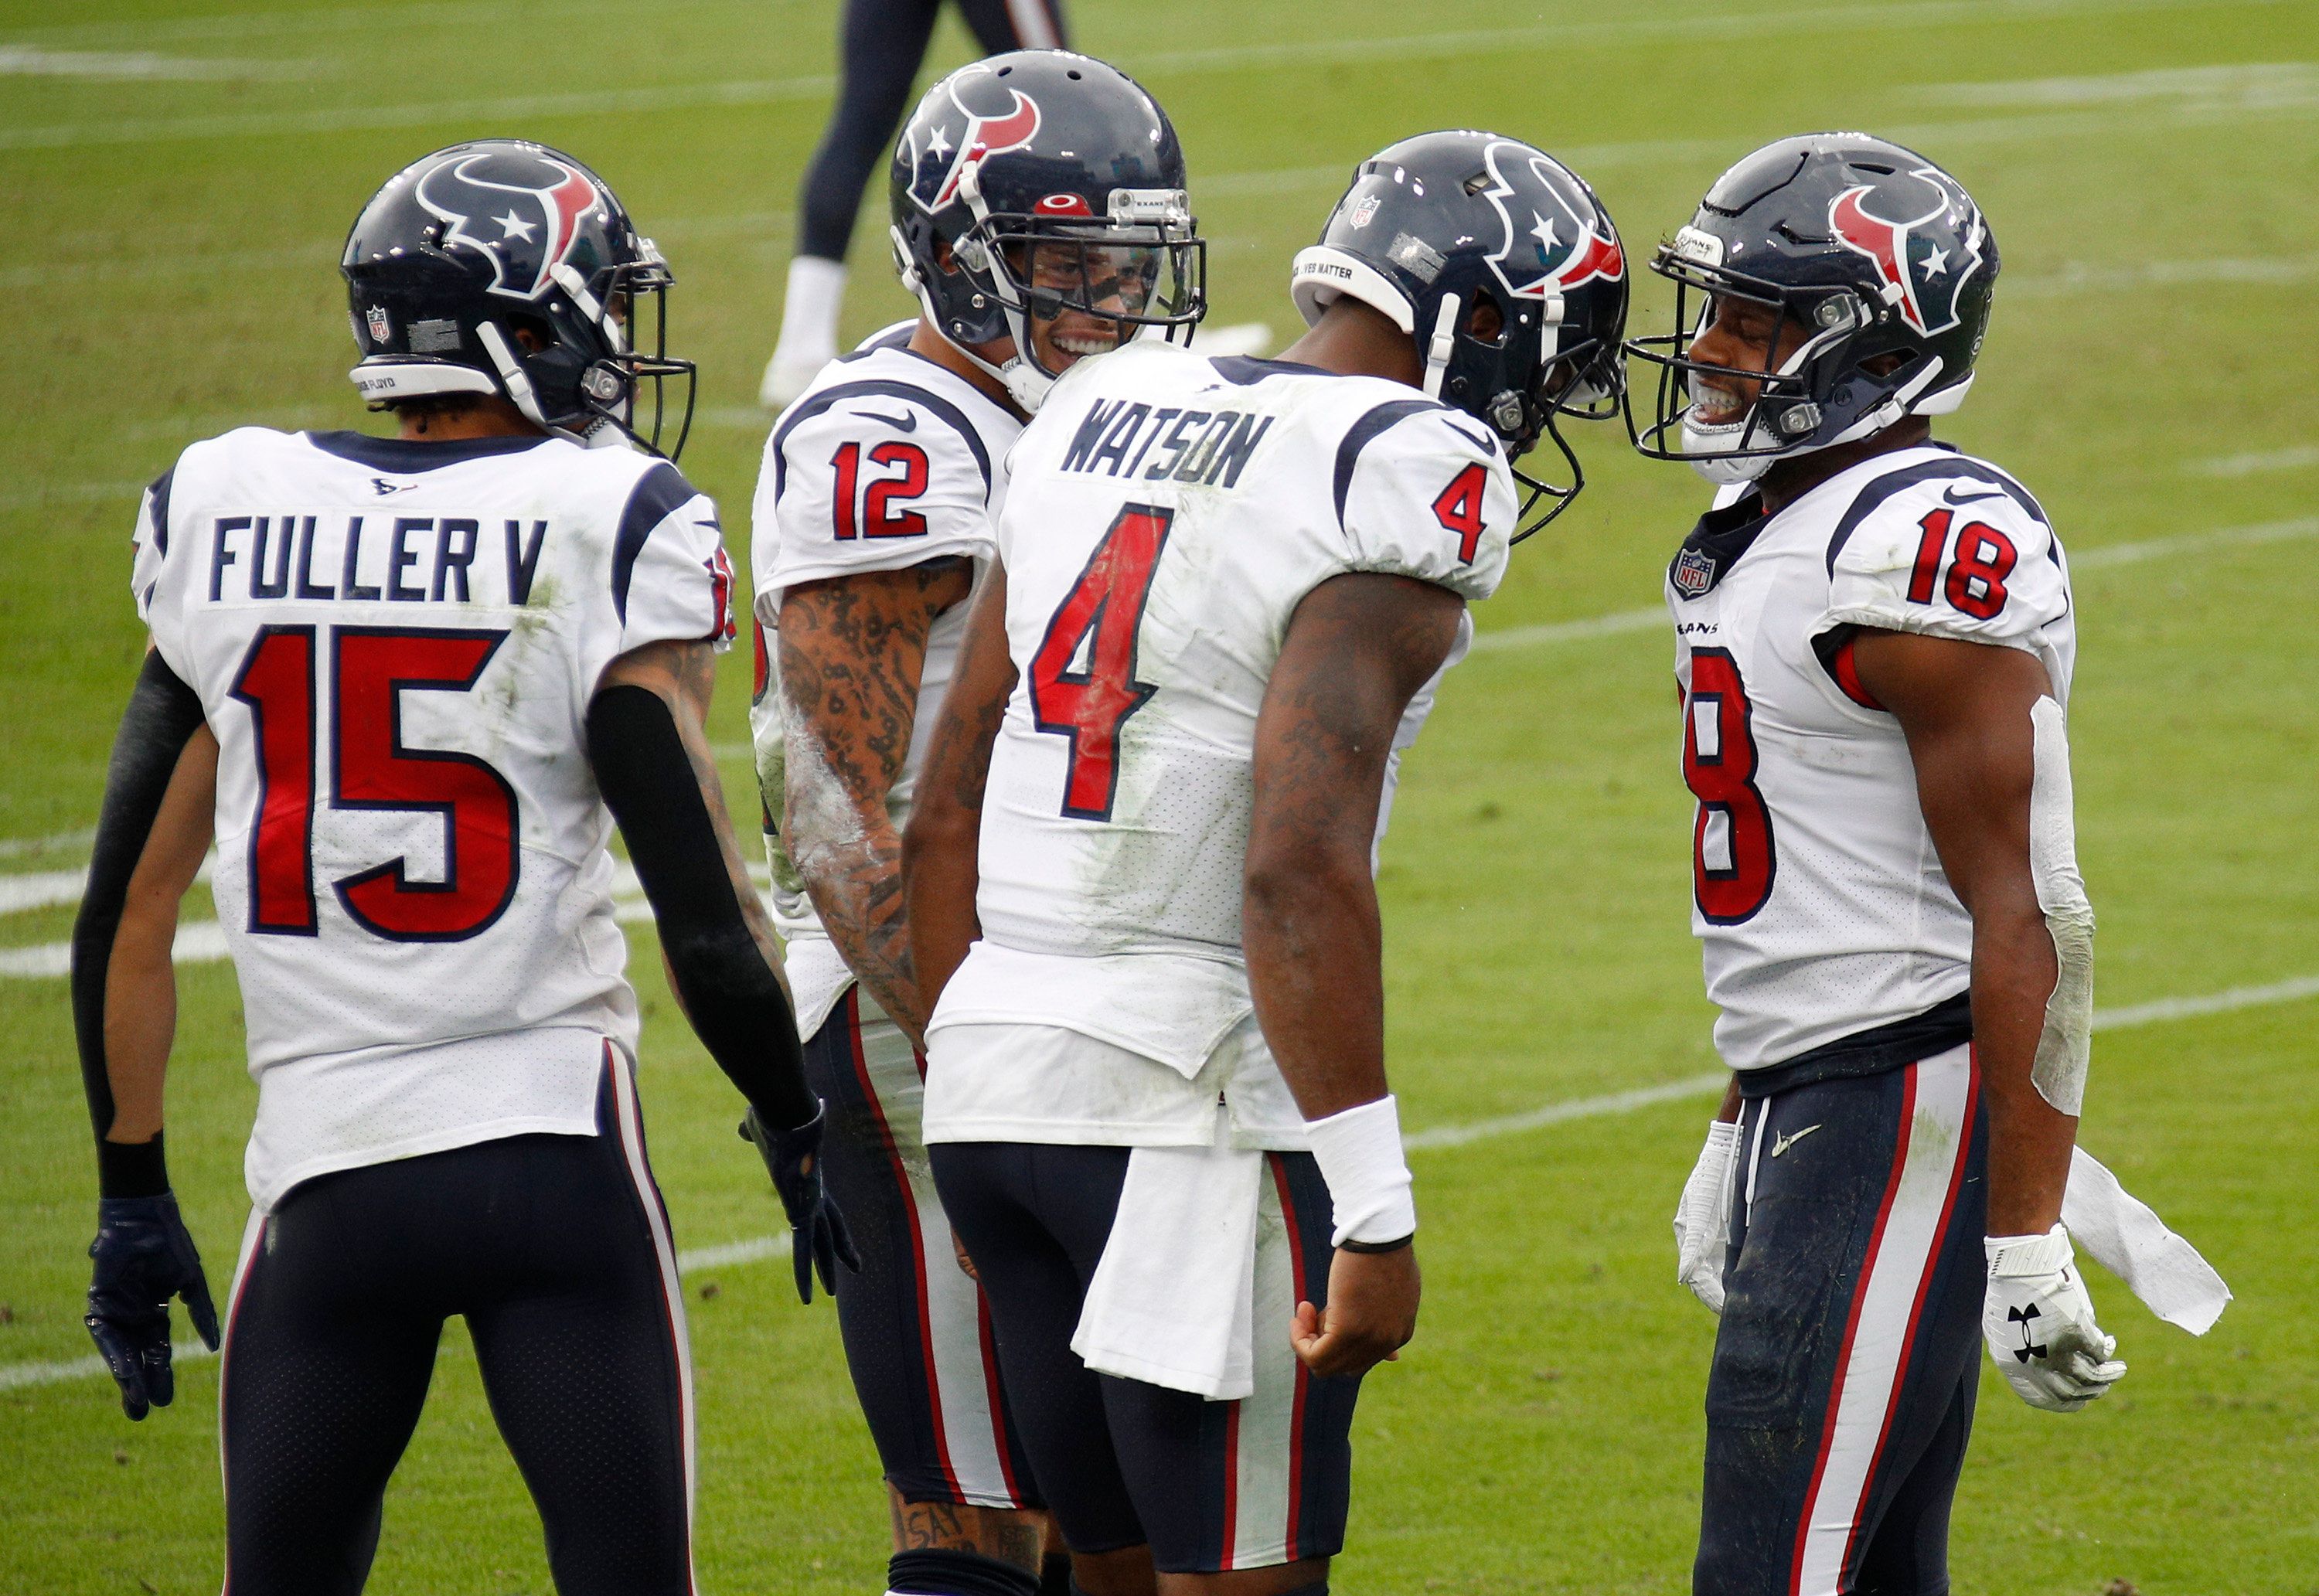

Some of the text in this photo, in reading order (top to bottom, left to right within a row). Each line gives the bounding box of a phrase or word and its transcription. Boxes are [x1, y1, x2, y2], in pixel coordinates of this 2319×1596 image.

[1318, 263, 1353, 279] MATTER
[371, 322, 388, 337] NFL
[368, 377, 395, 390] FLOYD
[1060, 397, 1275, 488] WATSON
[829, 441, 929, 541] 12
[1432, 461, 1488, 566] 4
[209, 515, 547, 604] FULLER V
[1679, 567, 1708, 587] NFL
[1906, 509, 2018, 618] 18
[1029, 502, 1175, 822] 4
[226, 623, 520, 942] 15
[1677, 646, 1777, 926] 8
